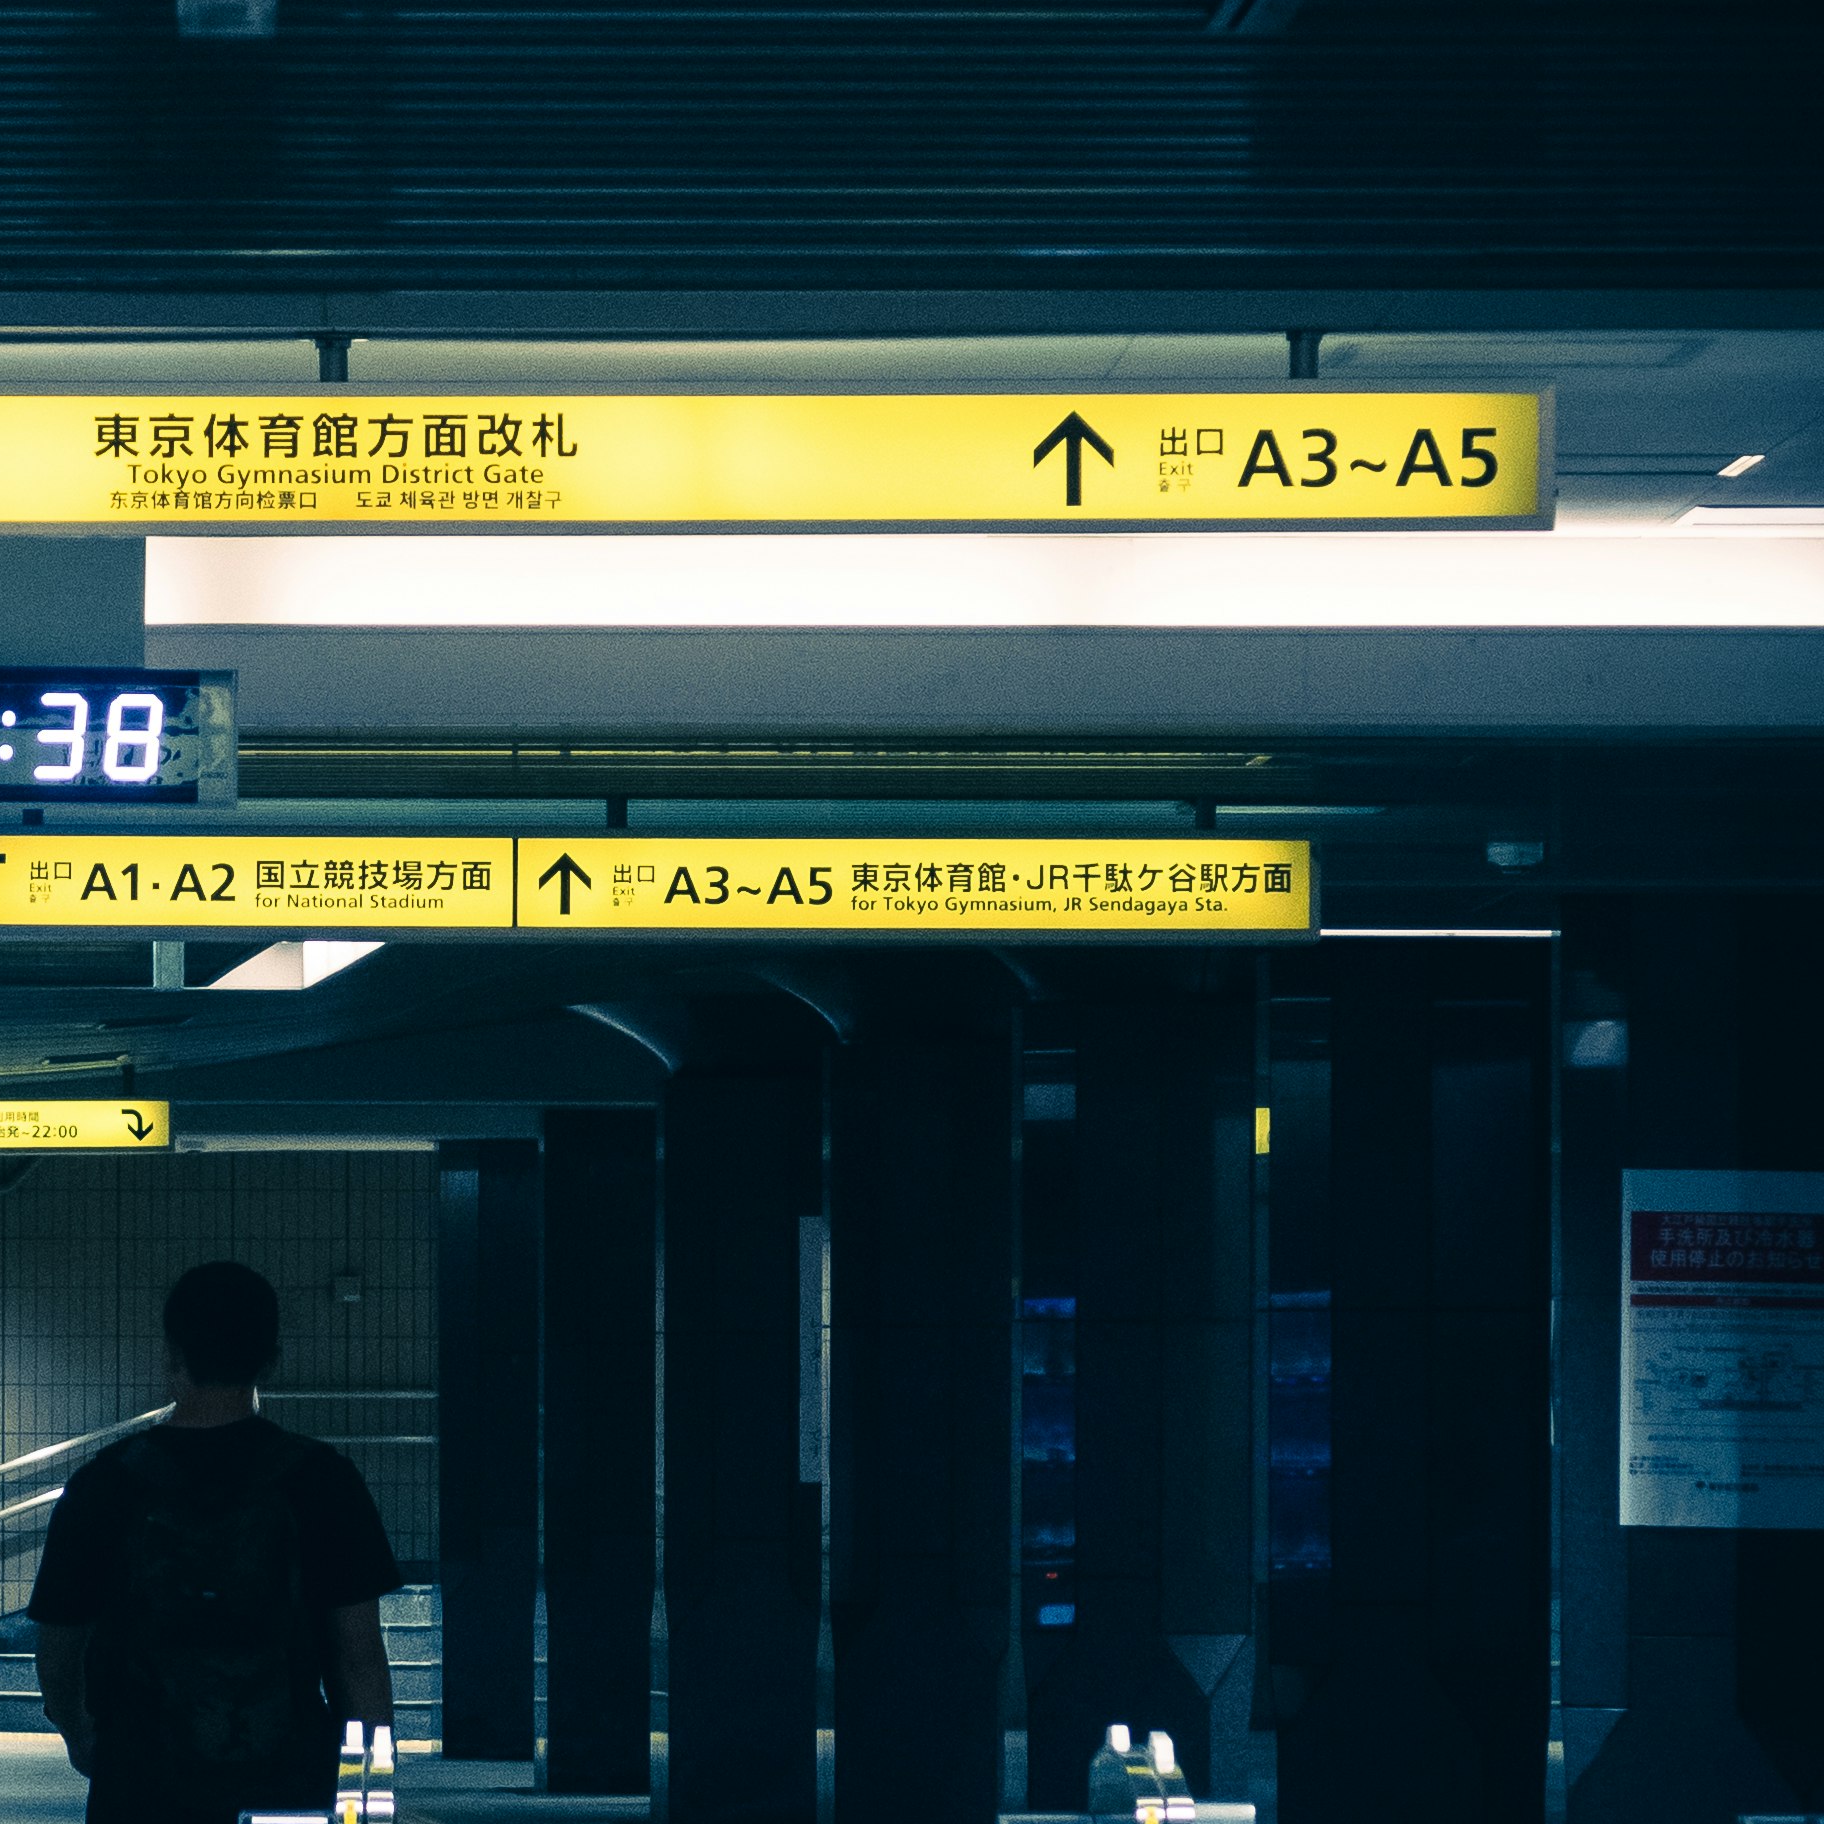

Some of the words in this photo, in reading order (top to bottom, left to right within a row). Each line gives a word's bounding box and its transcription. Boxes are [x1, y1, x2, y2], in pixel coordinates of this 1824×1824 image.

[94, 413, 578, 458] 東京体育館方面改札
[1160, 427, 1223, 456] 出口
[128, 464, 207, 489] Tokyo
[218, 464, 371, 490] Gymnasium
[383, 463, 474, 484] District
[484, 464, 544, 484] Gate
[1159, 461, 1194, 476] Exit
[110, 491, 318, 511] 东京体育馆方向检票口
[356, 492, 392, 510] 도쿄
[400, 491, 454, 511] 체육관
[463, 491, 499, 511] 방면
[507, 491, 562, 511] 개찰구
[30, 861, 72, 880] 出口
[255, 860, 491, 891] 国立競技場方面
[614, 864, 655, 883] 出口
[29, 882, 52, 894] Exit
[613, 886, 635, 896] Exit
[255, 894, 280, 908] for
[287, 894, 362, 909] National
[370, 894, 443, 909] Stadium
[851, 896, 877, 911] for
[883, 896, 938, 914] Tokyo
[945, 896, 1057, 915] Gymnasium,
[1064, 897, 1082, 912] JR
[1089, 896, 1188, 915] Sendagaya
[1195, 897, 1228, 912] Sta.
